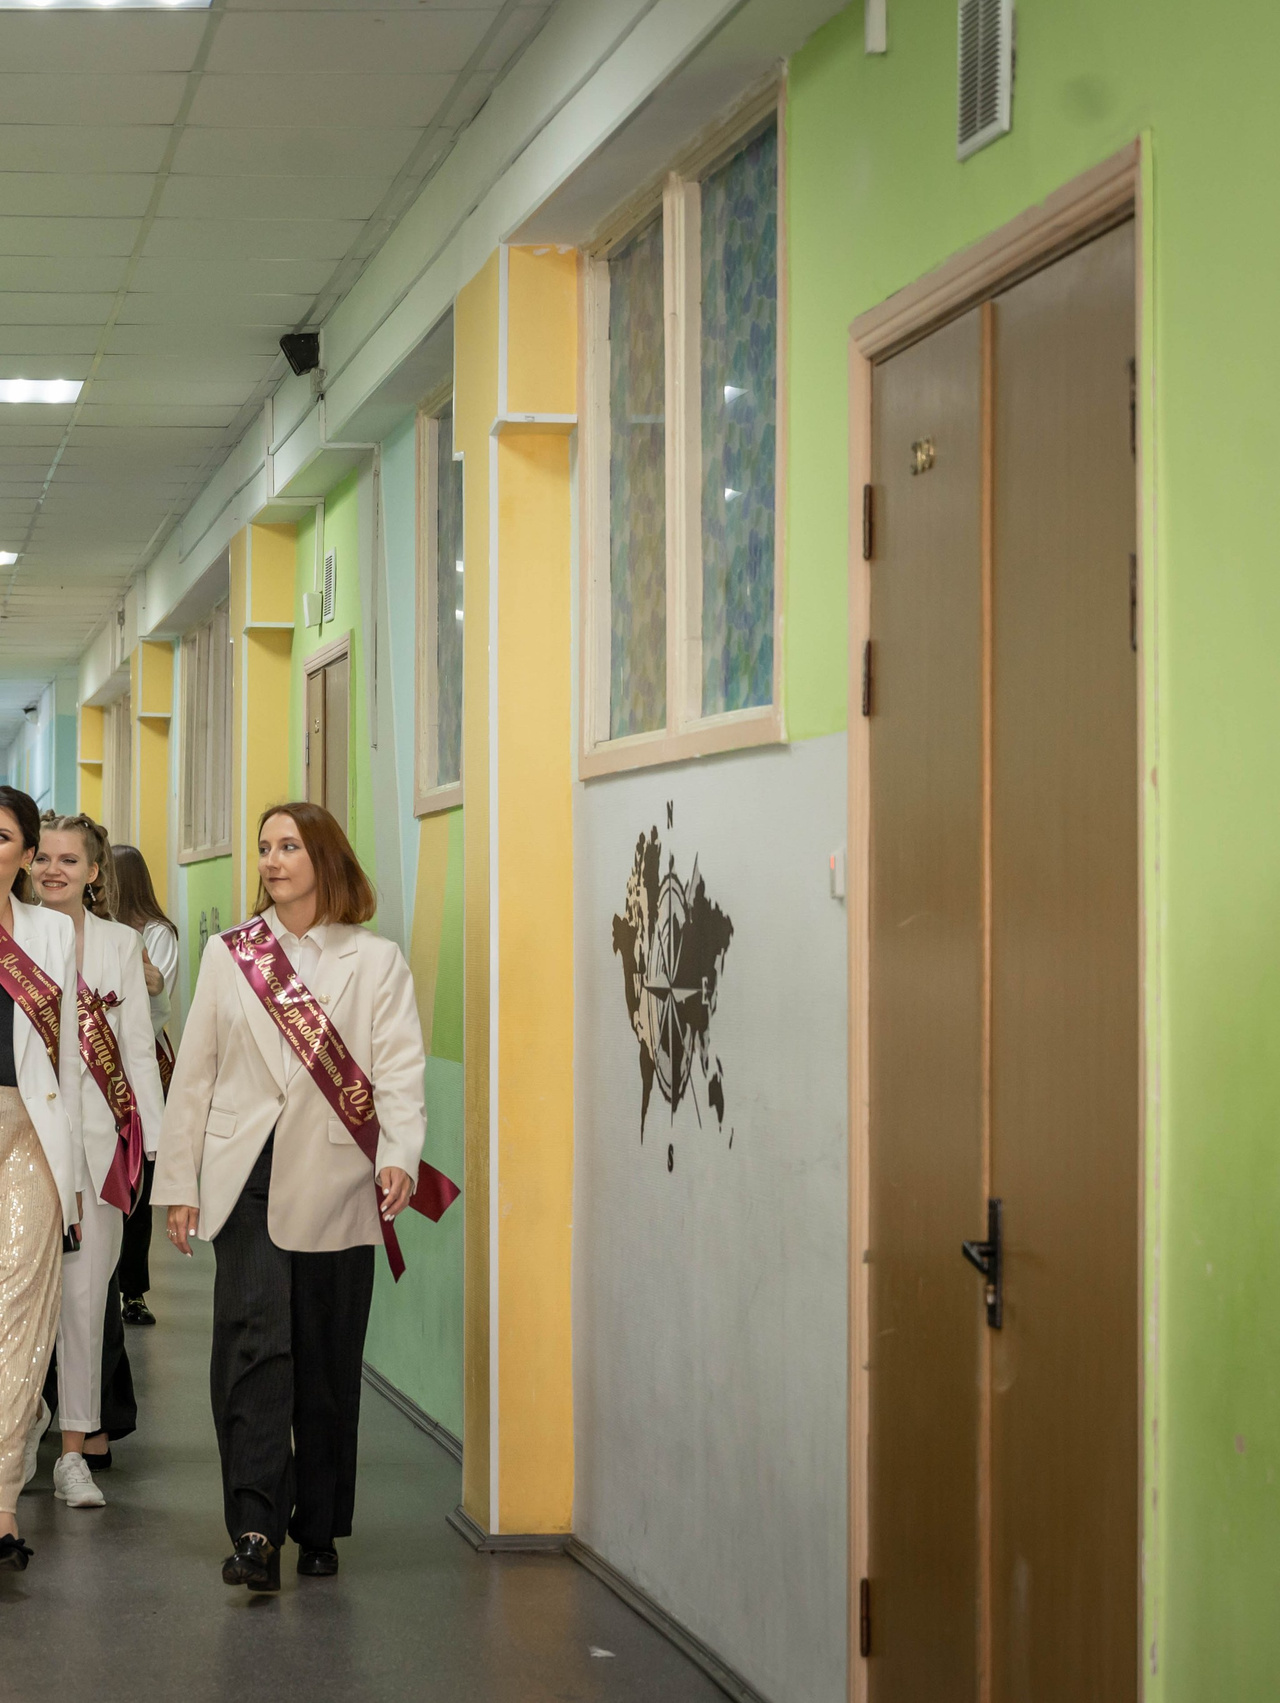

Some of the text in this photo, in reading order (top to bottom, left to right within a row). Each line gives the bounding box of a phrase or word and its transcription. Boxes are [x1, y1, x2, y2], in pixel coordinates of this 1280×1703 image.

[667, 800, 673, 829] N
[0, 952, 52, 1008] Классный
[702, 976, 709, 1005] E
[255, 953, 376, 1120] Классный руководитель 2024
[668, 1144, 673, 1173] S
